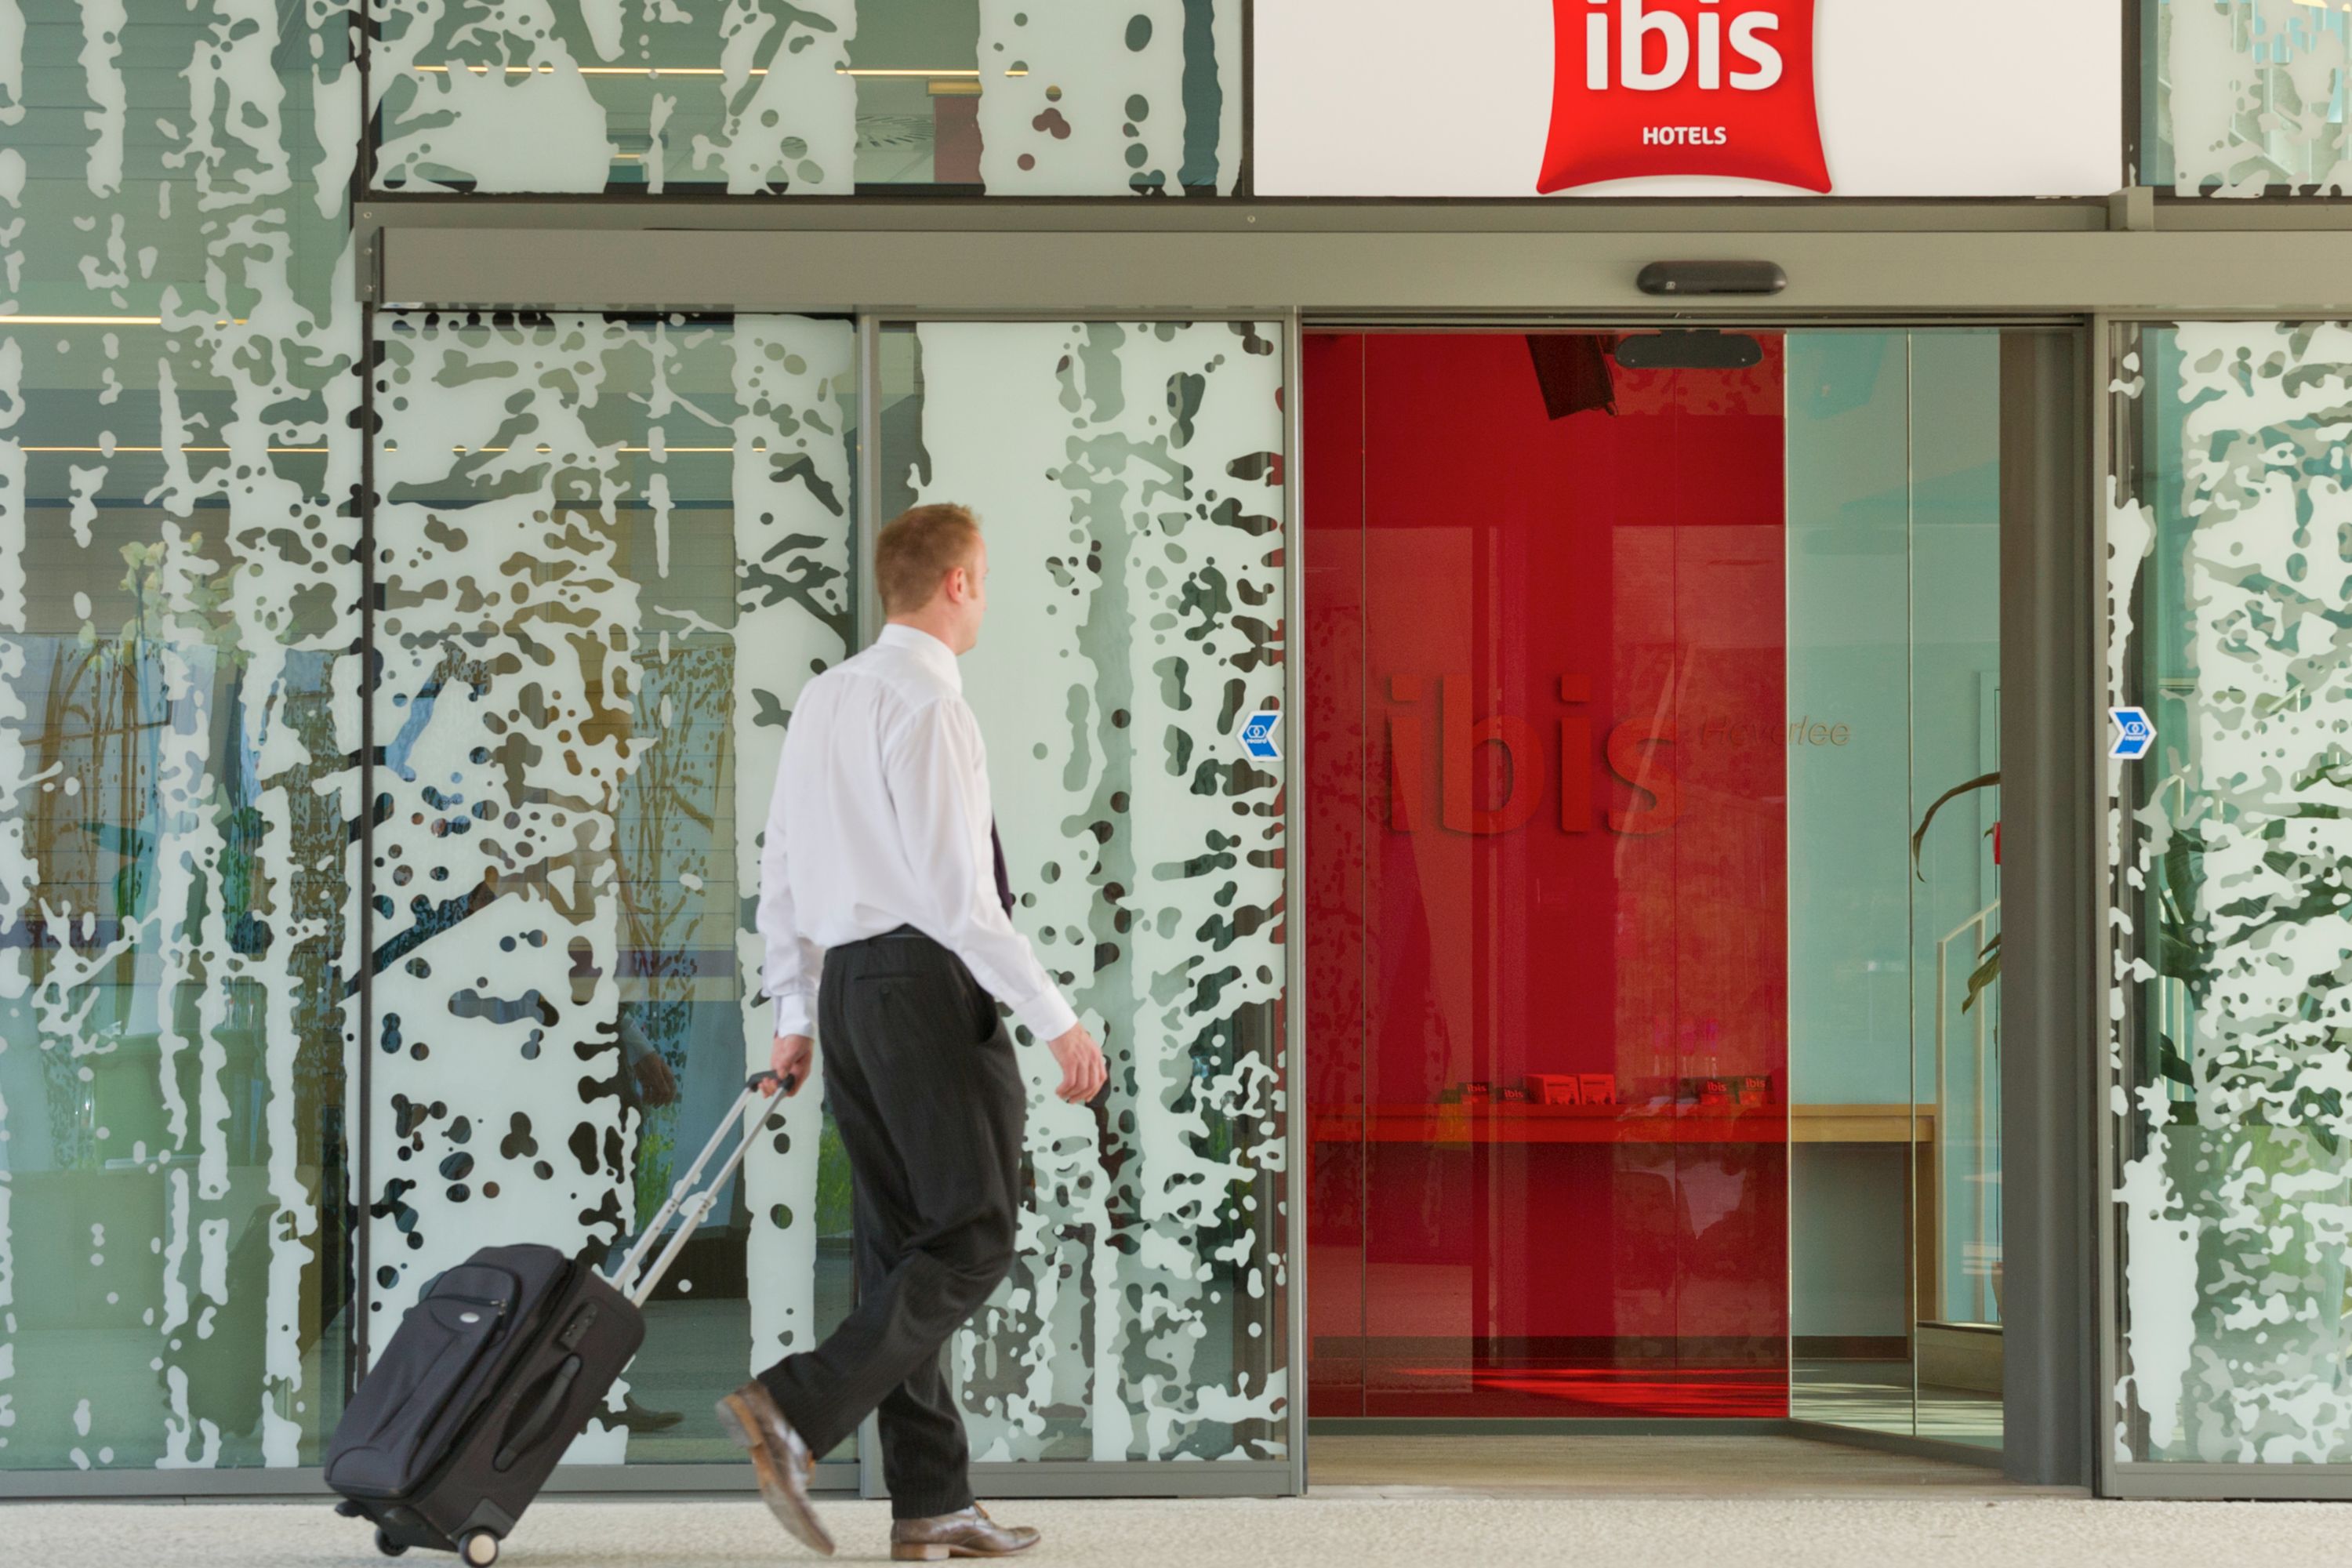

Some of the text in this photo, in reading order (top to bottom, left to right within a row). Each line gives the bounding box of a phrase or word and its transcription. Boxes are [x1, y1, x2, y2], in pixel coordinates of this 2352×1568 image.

[1586, 0, 1784, 91] ibis
[1642, 126, 1726, 145] HOTELS
[1389, 672, 1686, 835] ibis
[1467, 1083, 1487, 1092] ibis
[1707, 1080, 1727, 1092] ibis
[1745, 1078, 1766, 1088] ibis
[1504, 1089, 1524, 1098] ibis
